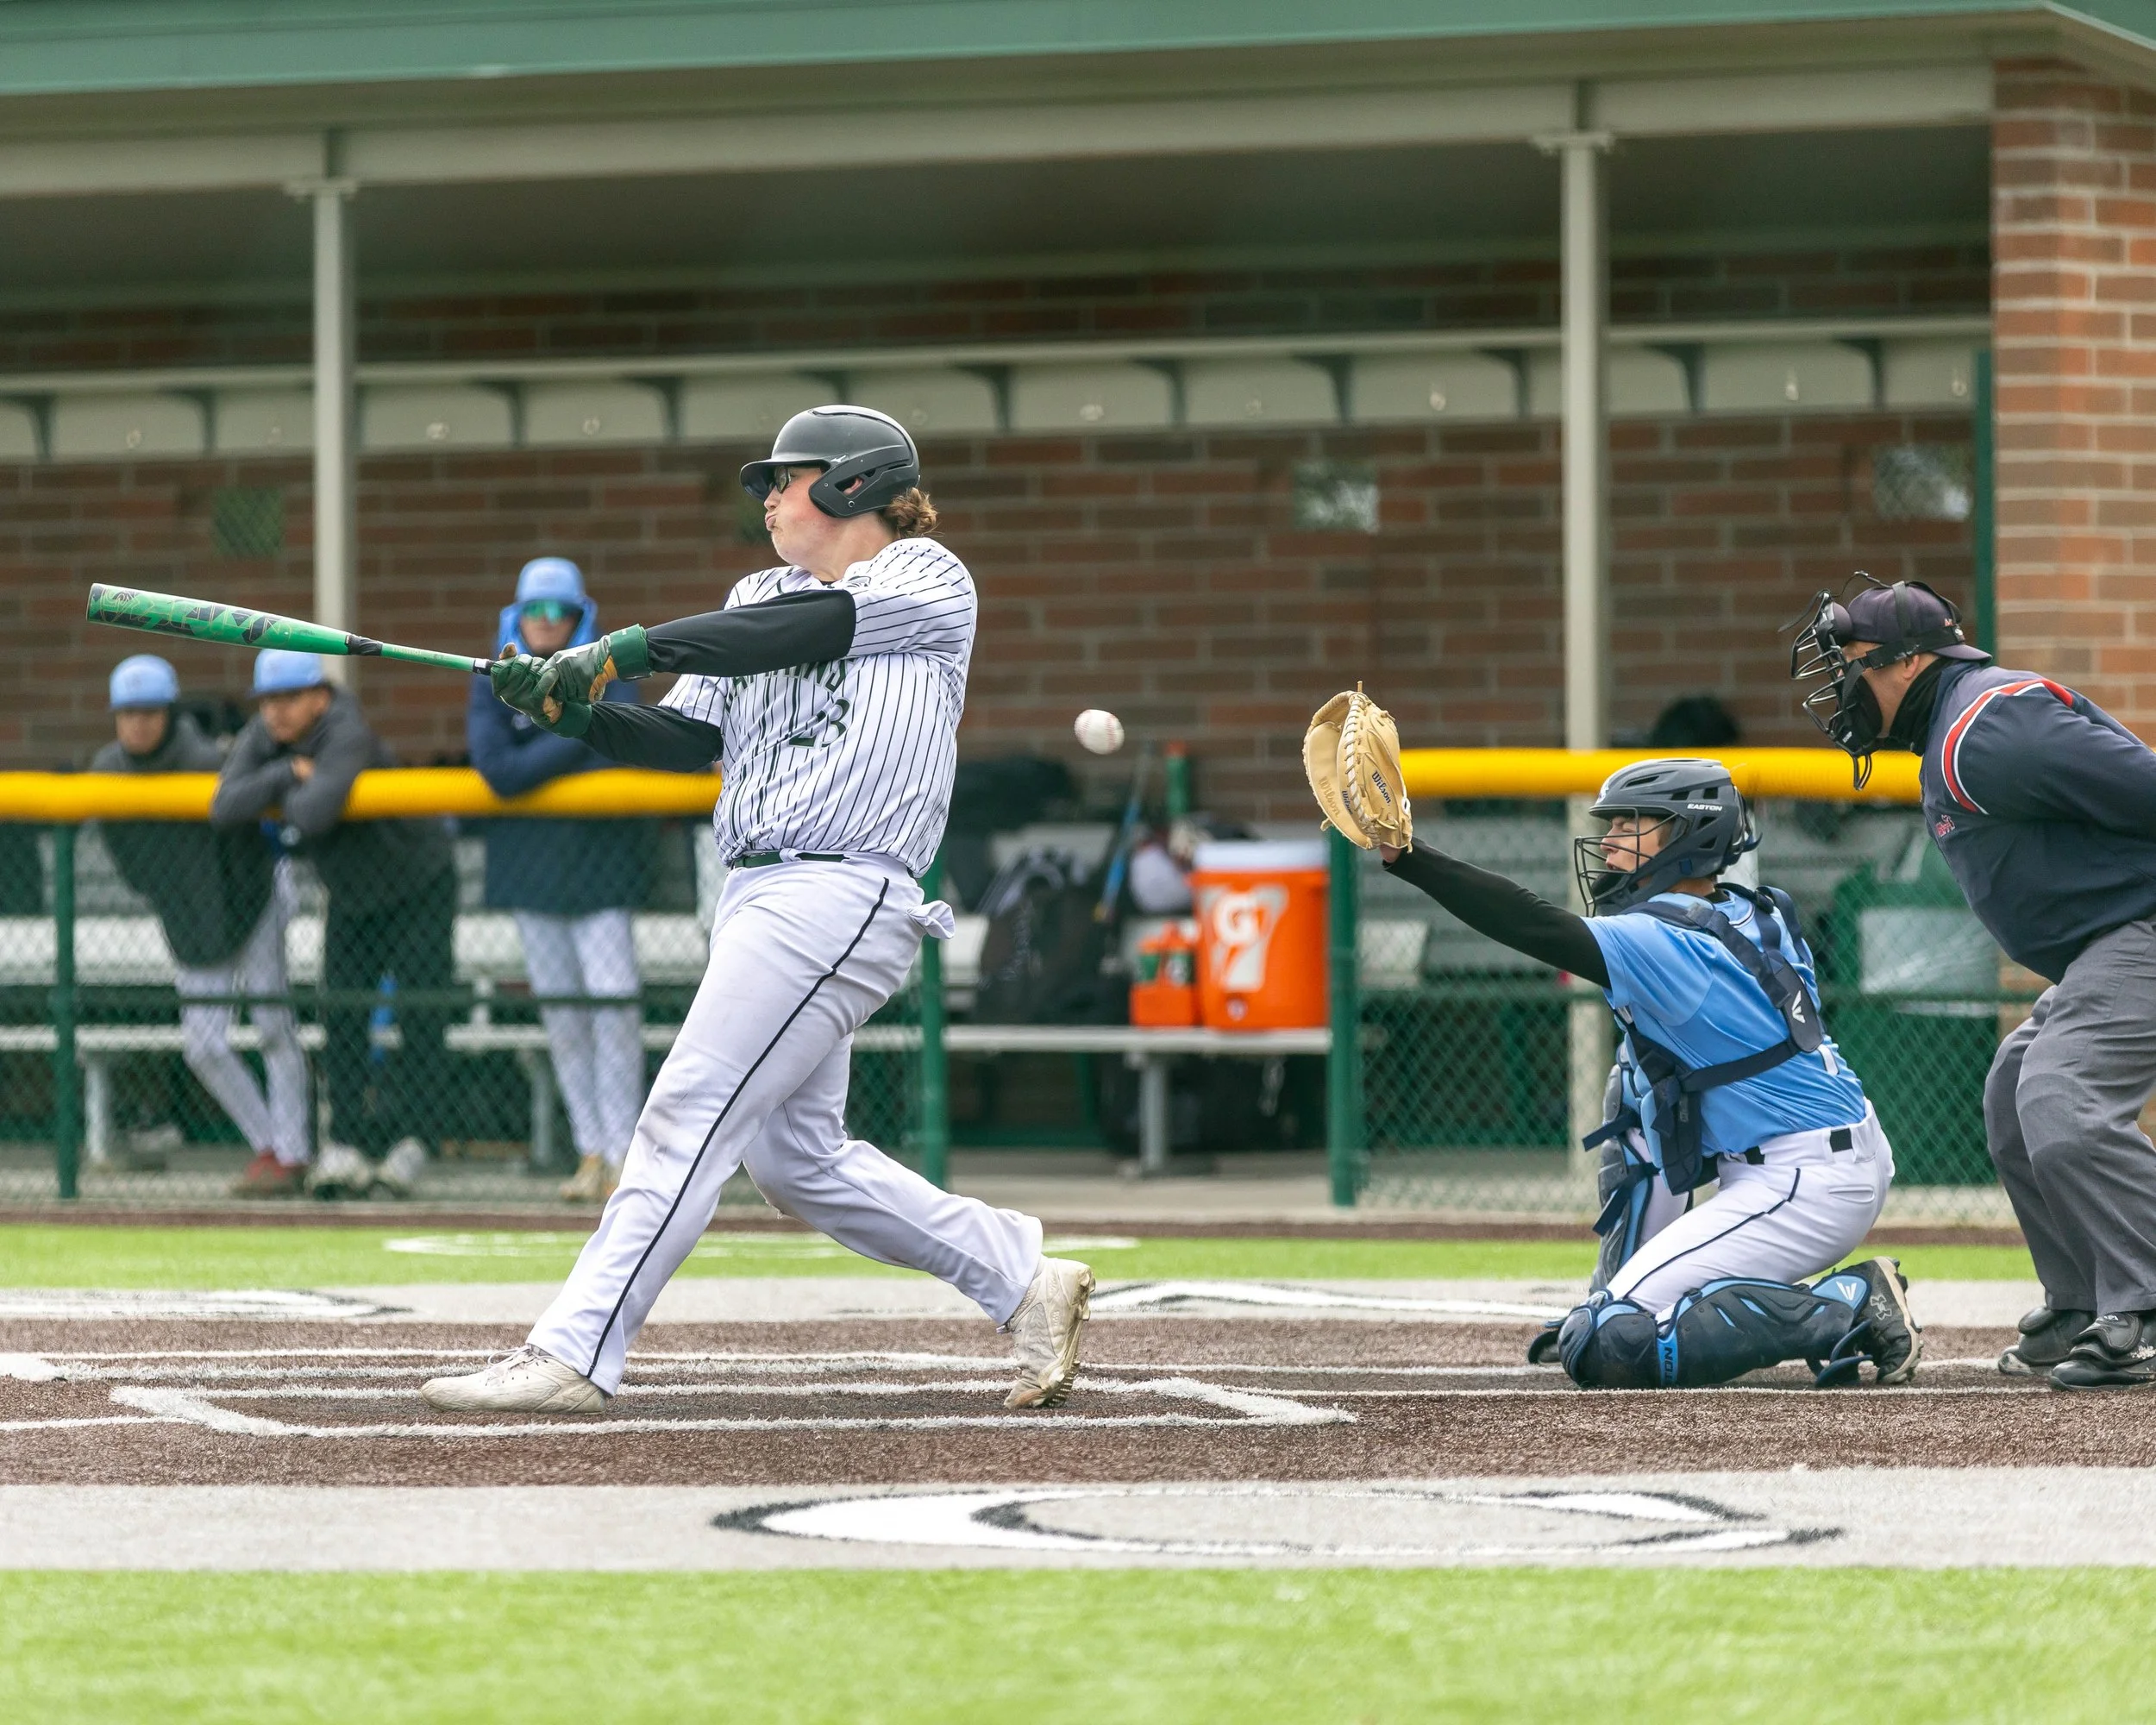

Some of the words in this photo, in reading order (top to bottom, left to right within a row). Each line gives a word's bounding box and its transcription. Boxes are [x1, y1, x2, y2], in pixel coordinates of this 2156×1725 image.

[1319, 776, 1340, 816] Wilson
[1372, 770, 1391, 805] Wilson
[1687, 803, 1723, 812] EASTON
